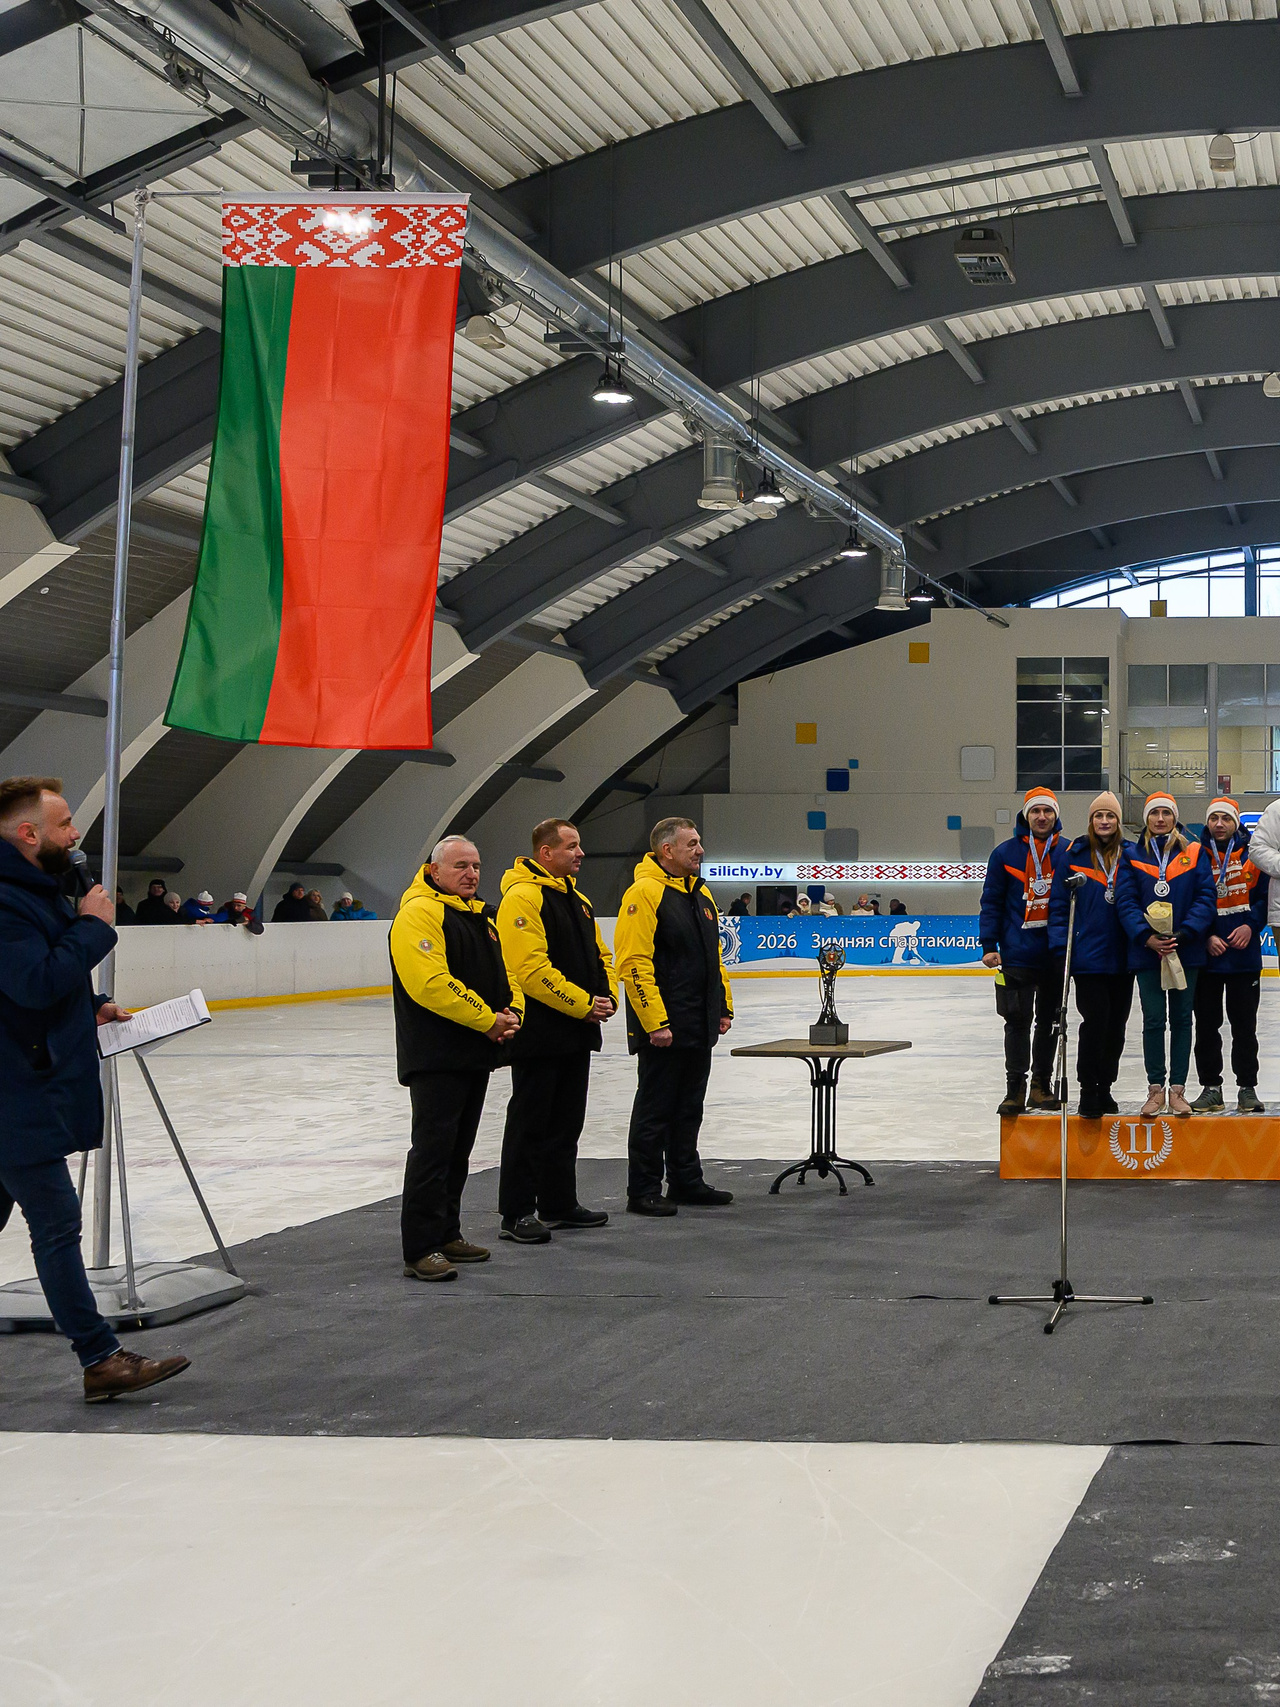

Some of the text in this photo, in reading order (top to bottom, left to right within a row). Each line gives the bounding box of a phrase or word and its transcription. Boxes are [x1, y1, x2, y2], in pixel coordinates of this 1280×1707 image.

[709, 865, 783, 878] silichy.by
[757, 933, 983, 953] 2026 Зимняя спартакиада
[447, 981, 482, 1011] BELARUS
[541, 977, 576, 1007] BELARUS
[631, 967, 649, 1009] BELARUS
[1126, 1123, 1156, 1153] II
